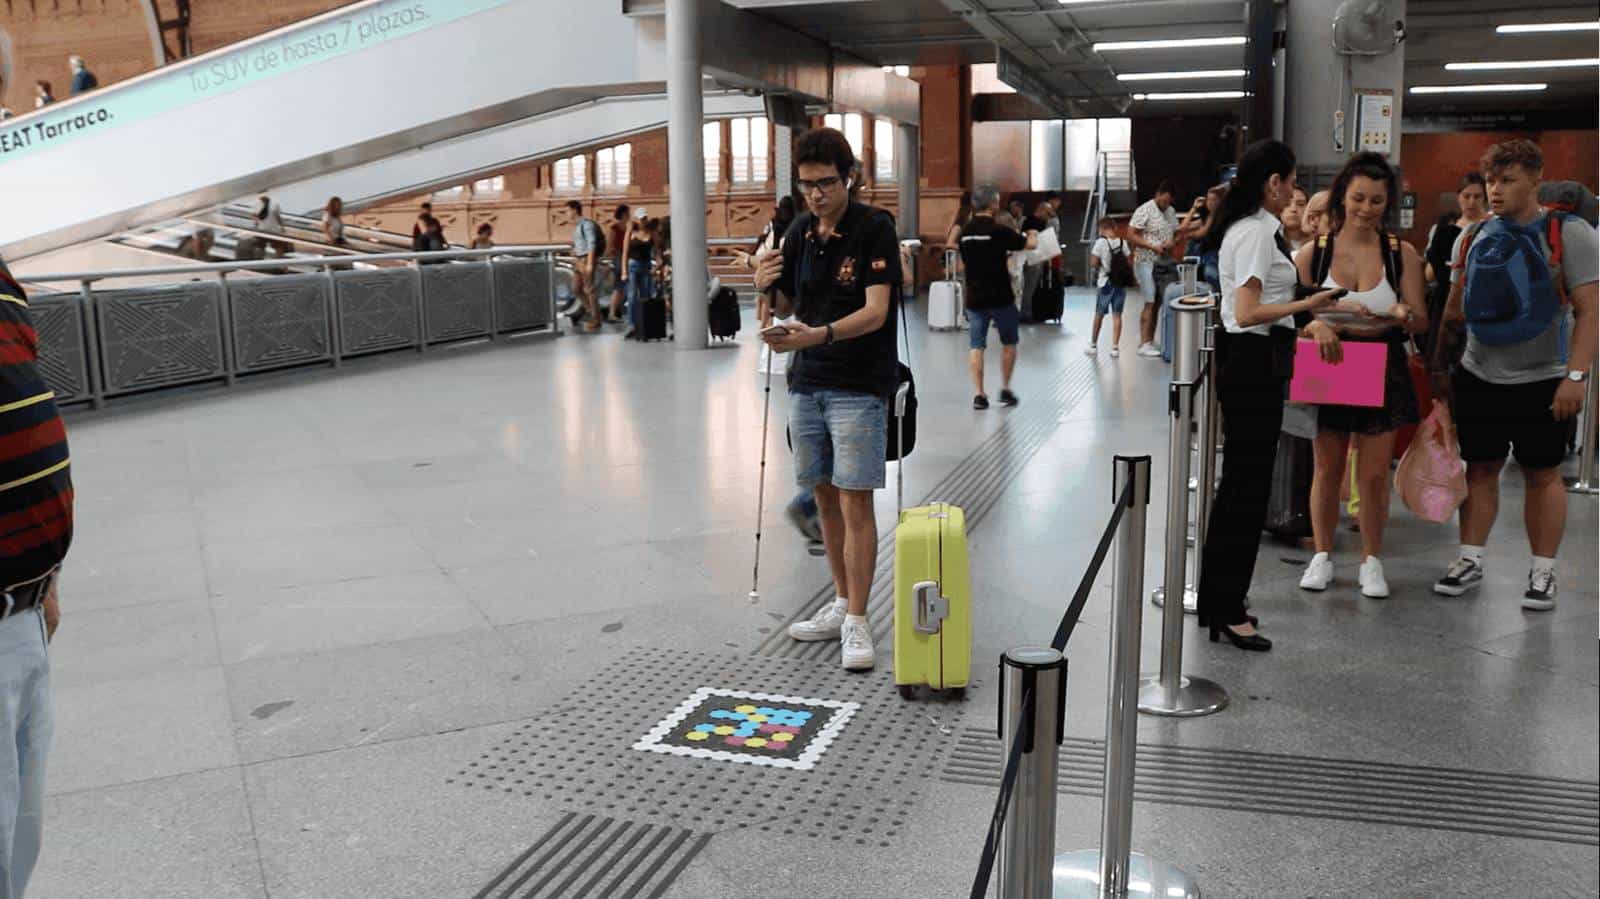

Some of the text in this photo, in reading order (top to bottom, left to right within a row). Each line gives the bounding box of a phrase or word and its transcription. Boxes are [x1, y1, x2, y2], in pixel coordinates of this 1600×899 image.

[189, 4, 430, 92] Tu SUV de hasta 7 plazas.
[0, 108, 115, 153] EAT Tarraco.
